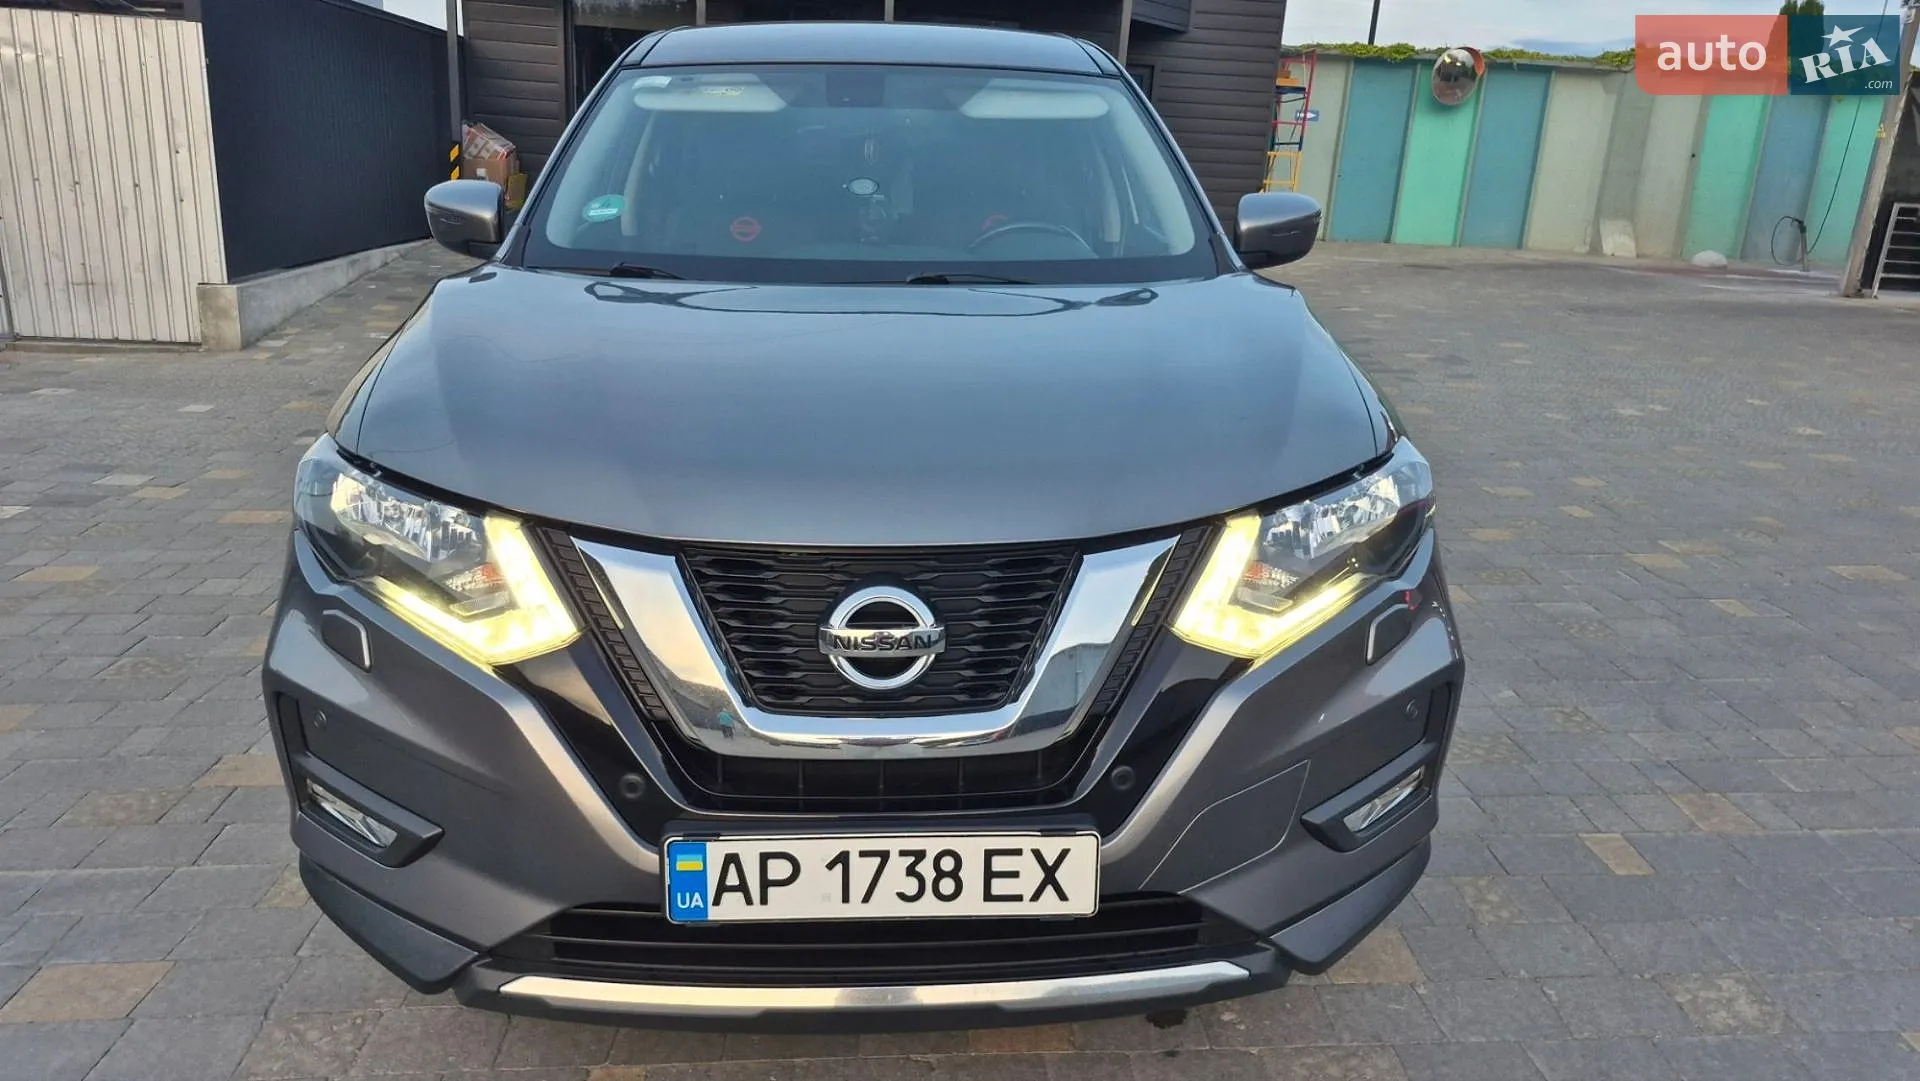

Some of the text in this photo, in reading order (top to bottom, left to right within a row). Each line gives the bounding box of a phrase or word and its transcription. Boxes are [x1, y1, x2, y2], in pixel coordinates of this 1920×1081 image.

[832, 634, 932, 651] NISSAN
[711, 847, 1071, 907] AP 1738 EX
[676, 892, 704, 909] UA
